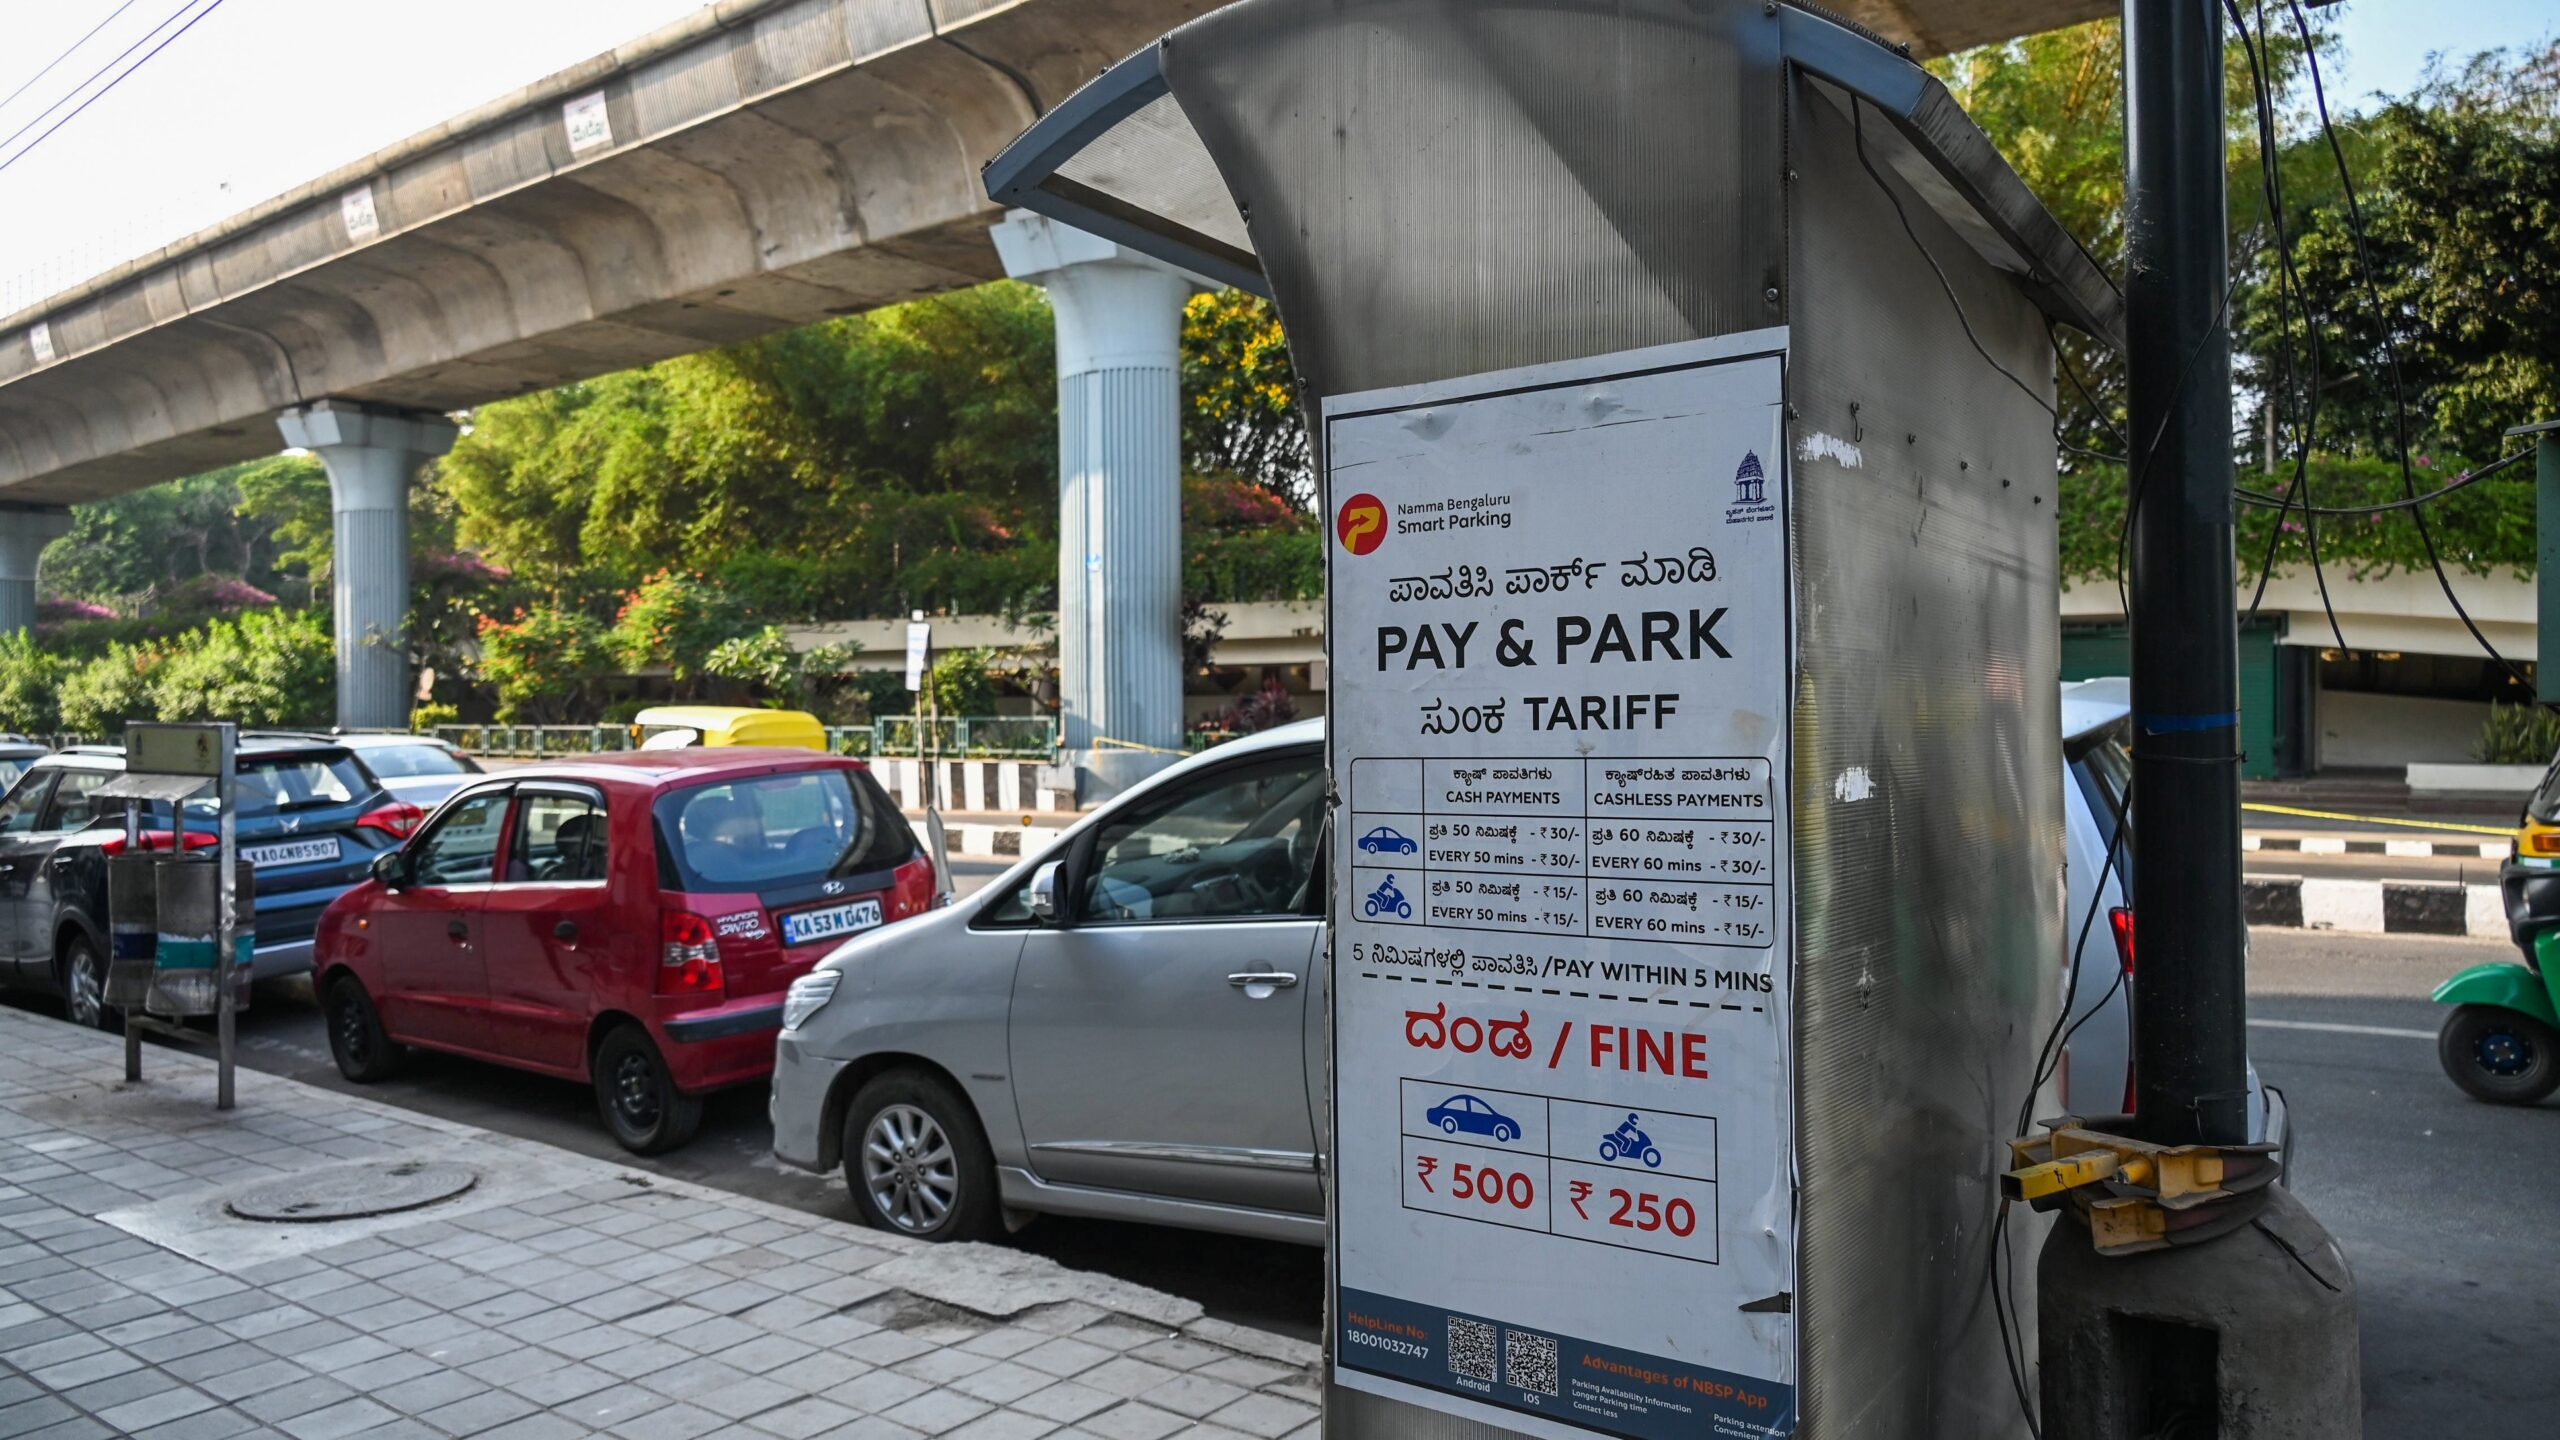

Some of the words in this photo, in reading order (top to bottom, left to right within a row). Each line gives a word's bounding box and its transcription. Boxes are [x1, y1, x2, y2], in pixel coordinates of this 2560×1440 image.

[1398, 502, 1443, 515] Namma
[1448, 494, 1510, 511] Bengaluru
[1398, 517, 1444, 534] Smart
[1450, 511, 1511, 528] Parking
[1389, 565, 1494, 602] ಪಾವತಿಸಿ
[1506, 557, 1606, 594] ಪಾರ್ಕ್
[1621, 547, 1716, 587] ಮಾಡಿ
[1377, 621, 1479, 672] PAY
[1495, 619, 1537, 667] &
[1557, 607, 1732, 665] PARK
[1420, 697, 1506, 734] ಸುಂಕ
[1523, 694, 1679, 731] TARIFF
[1453, 768, 1487, 786] ಕ್ಯಾಷ್
[1493, 767, 1552, 779] ಪಾವತಿಗಳು
[1682, 768, 1750, 781] ಪಾವತಿಗಳು
[1446, 791, 1482, 803] CASH
[1487, 792, 1560, 804] PAYMENTS
[1594, 793, 1672, 806] CASHLESS
[1677, 794, 1763, 807] PAYMENTS
[1429, 824, 1447, 839] ಪ್ರತಿ
[1453, 825, 1470, 836] 50
[1476, 826, 1517, 843] ನಿಮಿಷಕ್ಕೆ
[1593, 828, 1613, 845] ಪ್ರತಿ
[1620, 829, 1639, 841] 60
[1646, 830, 1694, 849] ನಿಮಿಷಕ್ಕೆ
[1429, 851, 1470, 861] EVERY
[1474, 852, 1490, 863] 50
[1495, 853, 1523, 864] mins
[1592, 857, 1639, 869] EVERY
[1644, 858, 1662, 870] 60
[1668, 859, 1701, 871] mins
[1432, 880, 1450, 896] ಪ್ರತಿ
[1456, 881, 1472, 893] 50
[1479, 884, 1520, 902] ನಿಮಿಷಕ್ಕೆ
[1596, 888, 1616, 905] ಪ್ರತಿ
[1623, 890, 1642, 902] 60
[1650, 892, 1697, 911] ನಿಮಿಷಕ್ಕೆ
[1432, 907, 1473, 919] EVERY
[1477, 909, 1493, 920] 50
[1498, 911, 1526, 922] mins
[1596, 916, 1643, 929] EVERY
[1648, 919, 1666, 931] 60
[1672, 921, 1705, 933] mins
[794, 920, 813, 936] KA
[815, 915, 831, 931] 53
[1353, 944, 1363, 960] 5
[1372, 943, 1465, 977] ನಿಮಿಷಗಳಲ್ಲಿ
[1472, 954, 1537, 975] ಪಾವತಿಸಿ
[1601, 962, 1686, 986] WITHIN
[1694, 969, 1707, 987] 5
[1715, 971, 1772, 993] MINS
[1405, 1002, 1533, 1059] ದಂಡ
[1548, 1022, 1572, 1069] /
[1591, 1024, 1708, 1079] FINE
[1417, 1156, 1438, 1193] ₹
[1453, 1164, 1534, 1209] 500
[1569, 1181, 1593, 1220] ₹
[1609, 1189, 1695, 1237] 250
[1348, 1312, 1404, 1335] HelpLine
[1347, 1330, 1428, 1359] 18001032747
[1457, 1377, 1490, 1392] Android
[1583, 1354, 1668, 1384] Advantages
[1673, 1376, 1688, 1388] of
[1693, 1380, 1733, 1398] NBSP
[1737, 1390, 1767, 1408] App
[1572, 1378, 1599, 1392] Parking
[1601, 1386, 1643, 1402] Availability
[1645, 1396, 1691, 1413] Information
[1572, 1389, 1597, 1400] Longer
[1600, 1396, 1627, 1410] Parking
[1630, 1404, 1647, 1413] time
[1574, 1401, 1601, 1414] Contact
[1604, 1410, 1617, 1418] less
[1714, 1414, 1744, 1428] Parking
[1714, 1425, 1760, 1440] Convenient
